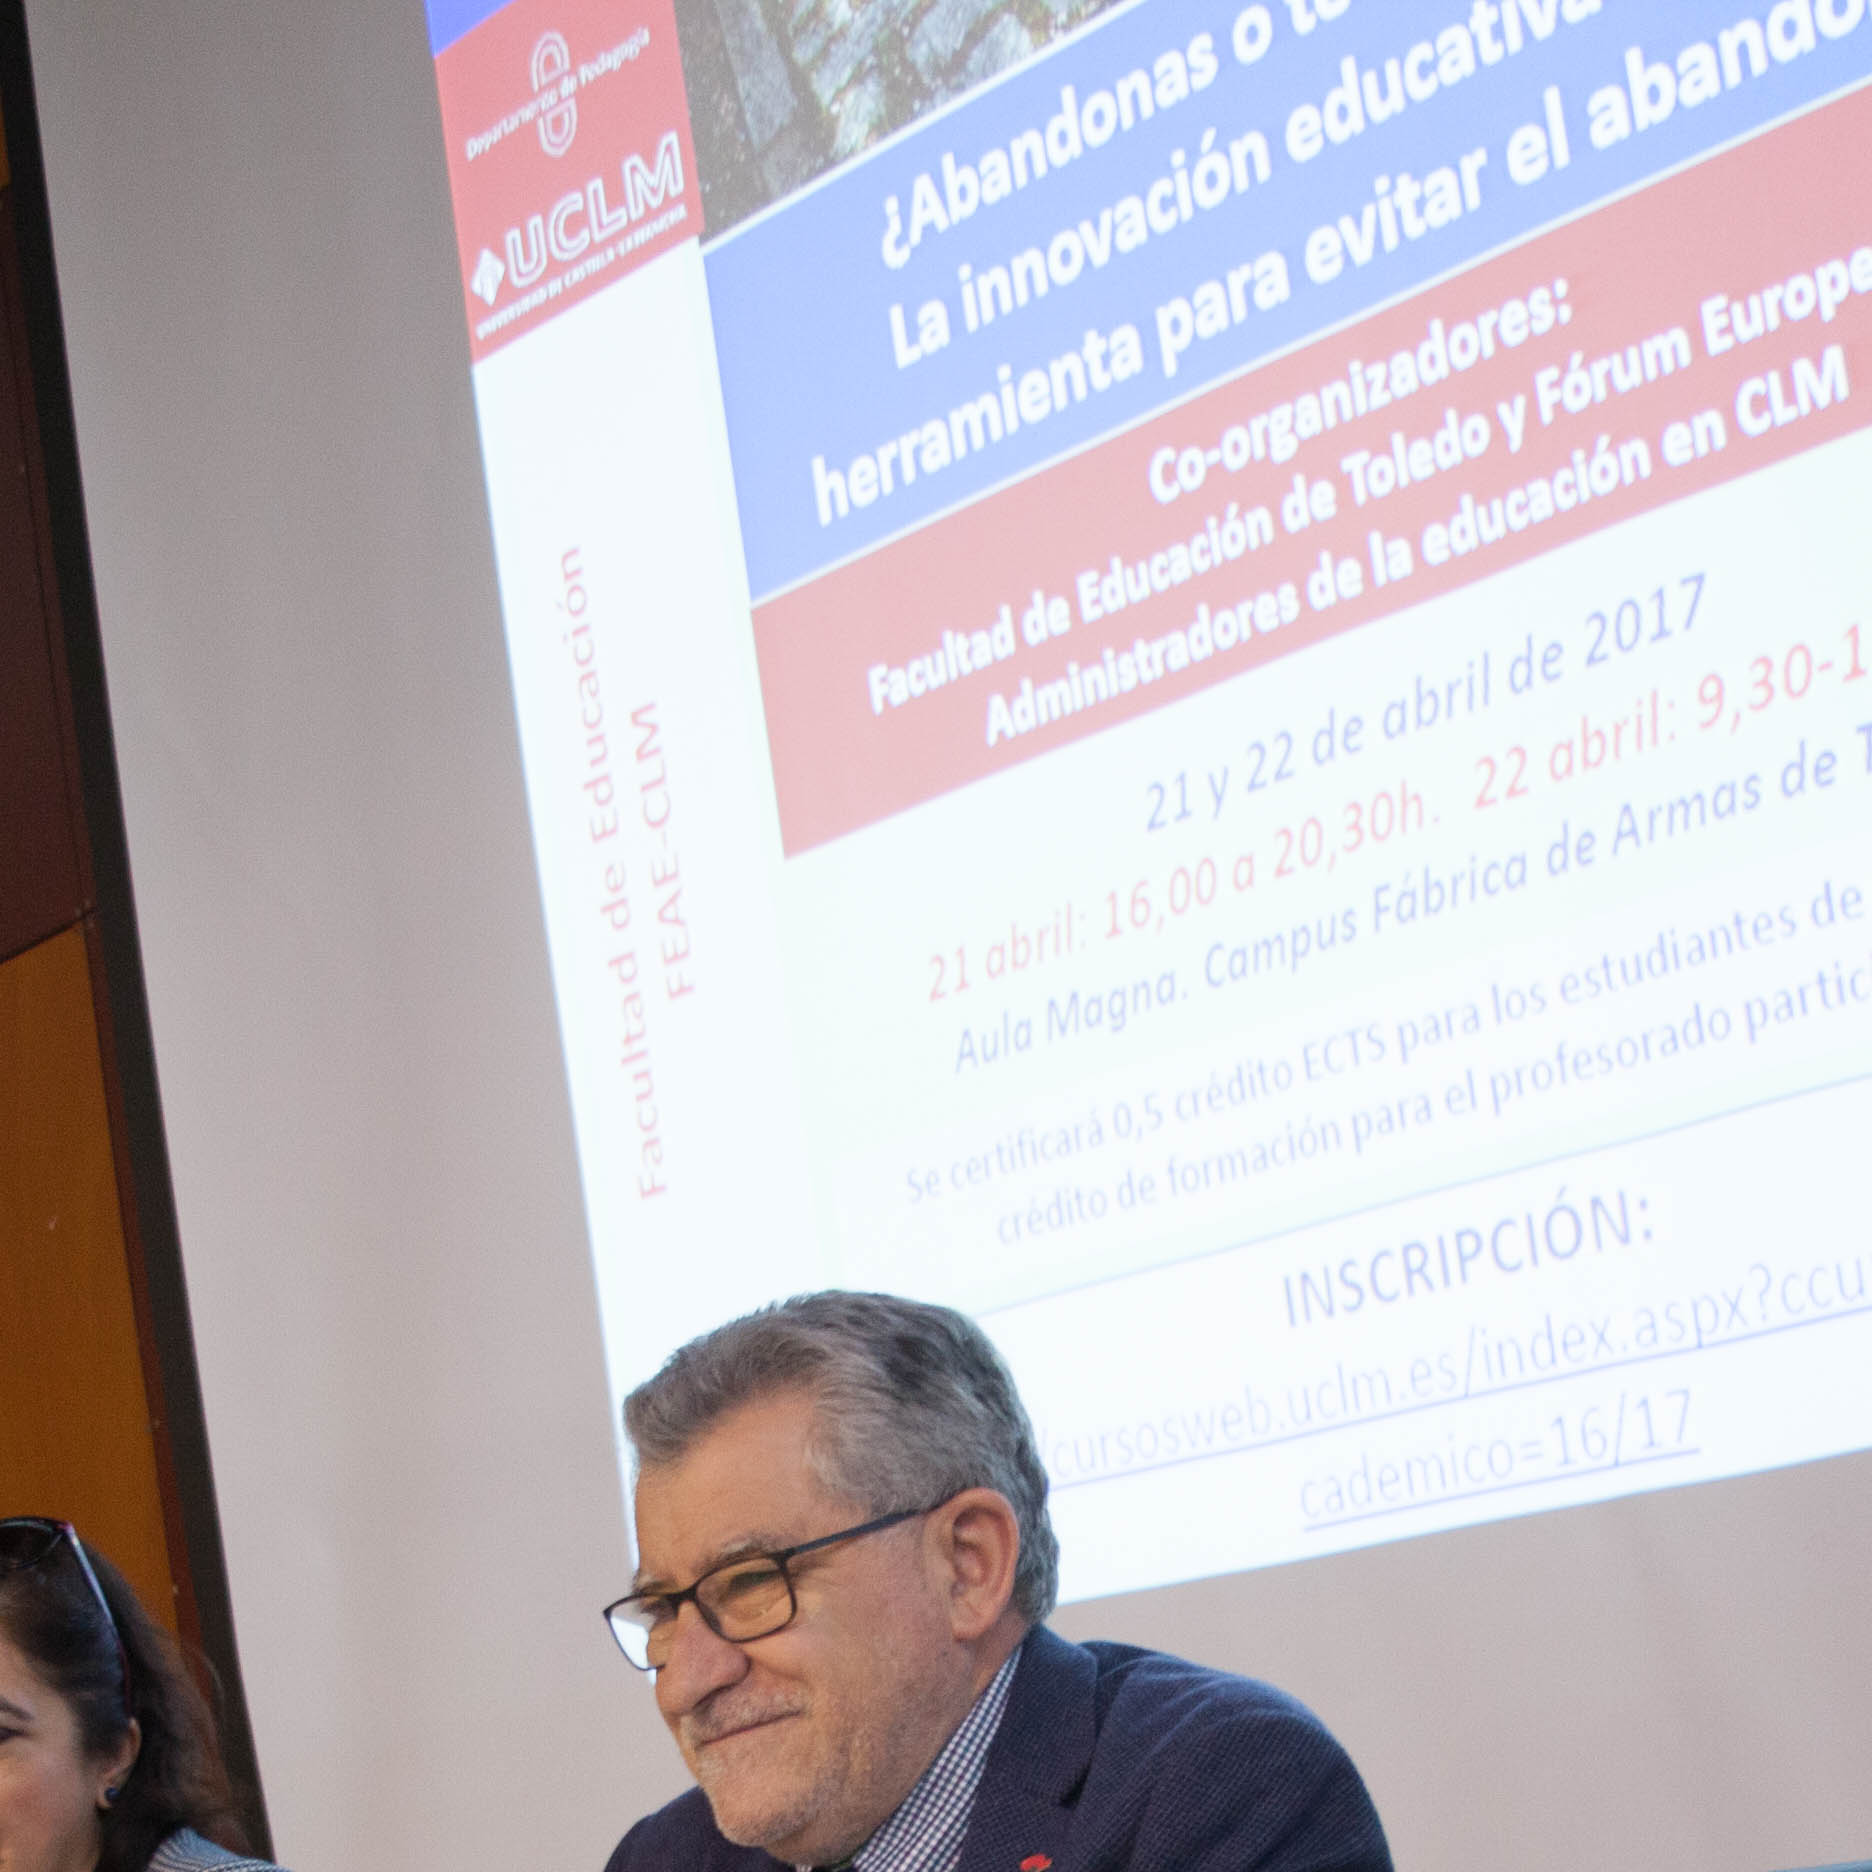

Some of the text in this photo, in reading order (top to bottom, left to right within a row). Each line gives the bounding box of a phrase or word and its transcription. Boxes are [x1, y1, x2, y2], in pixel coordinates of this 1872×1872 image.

[505, 129, 685, 288] UCLM
[881, 4, 1273, 270] ¿Abandonas o
[889, 299, 951, 370] La
[958, 127, 1271, 333] innovación
[811, 323, 1144, 528] herramienta
[1155, 250, 1291, 378] para
[1304, 146, 1488, 285] evitar
[1507, 84, 1570, 186] el
[1148, 277, 1573, 505] Co-organizadores:
[868, 603, 1016, 716] Facultad
[1022, 588, 1071, 647] de
[1077, 502, 1274, 625] Educación
[1281, 473, 1337, 534] de
[1340, 407, 1491, 507] Toledo
[1497, 393, 1527, 454] y
[1534, 350, 1692, 425] Fórum
[986, 344, 1850, 748] Administradores de la educación en CLM
[1146, 571, 1707, 831] 21 y 22 de abril de 2017
[555, 545, 667, 1200] Facultad de Educación
[629, 700, 695, 1002] FEAE-CLM
[929, 946, 970, 1002] 21
[985, 900, 1087, 980] abril:
[1105, 856, 1217, 940] 16,00
[1232, 852, 1255, 892] a
[1273, 778, 1441, 879] 20,30h.
[1473, 745, 1530, 810] 22
[1549, 688, 1676, 782] abril:
[955, 1007, 1033, 1075] Aula
[1046, 968, 1190, 1043] Magna.
[1204, 907, 1358, 989] Campus
[1373, 853, 1528, 934] Fábrica
[1547, 820, 1596, 877] de
[1612, 772, 1762, 857] Armas
[1780, 738, 1838, 799] de
[906, 1165, 941, 1204] Se
[950, 1108, 1106, 1192] certificará
[1112, 1091, 1165, 1143] 0,5
[1175, 1058, 1294, 1122] crédito
[1302, 1022, 1387, 1085] ECTS
[1396, 1001, 1481, 1065] para
[1491, 981, 1548, 1026] los
[1559, 904, 1798, 1004] estudiantes
[1810, 880, 1865, 929] de
[996, 1184, 1109, 1246] crédito
[1117, 1169, 1158, 1210] de
[1166, 1116, 1344, 1196] formación
[1351, 1094, 1433, 1155] para
[1444, 1068, 1478, 1116] el
[1489, 1001, 1731, 1117] profesorado
[1283, 1185, 1654, 1328] INSCRIPCIÓN:
[1300, 1388, 1691, 1522] cademico=16/17
